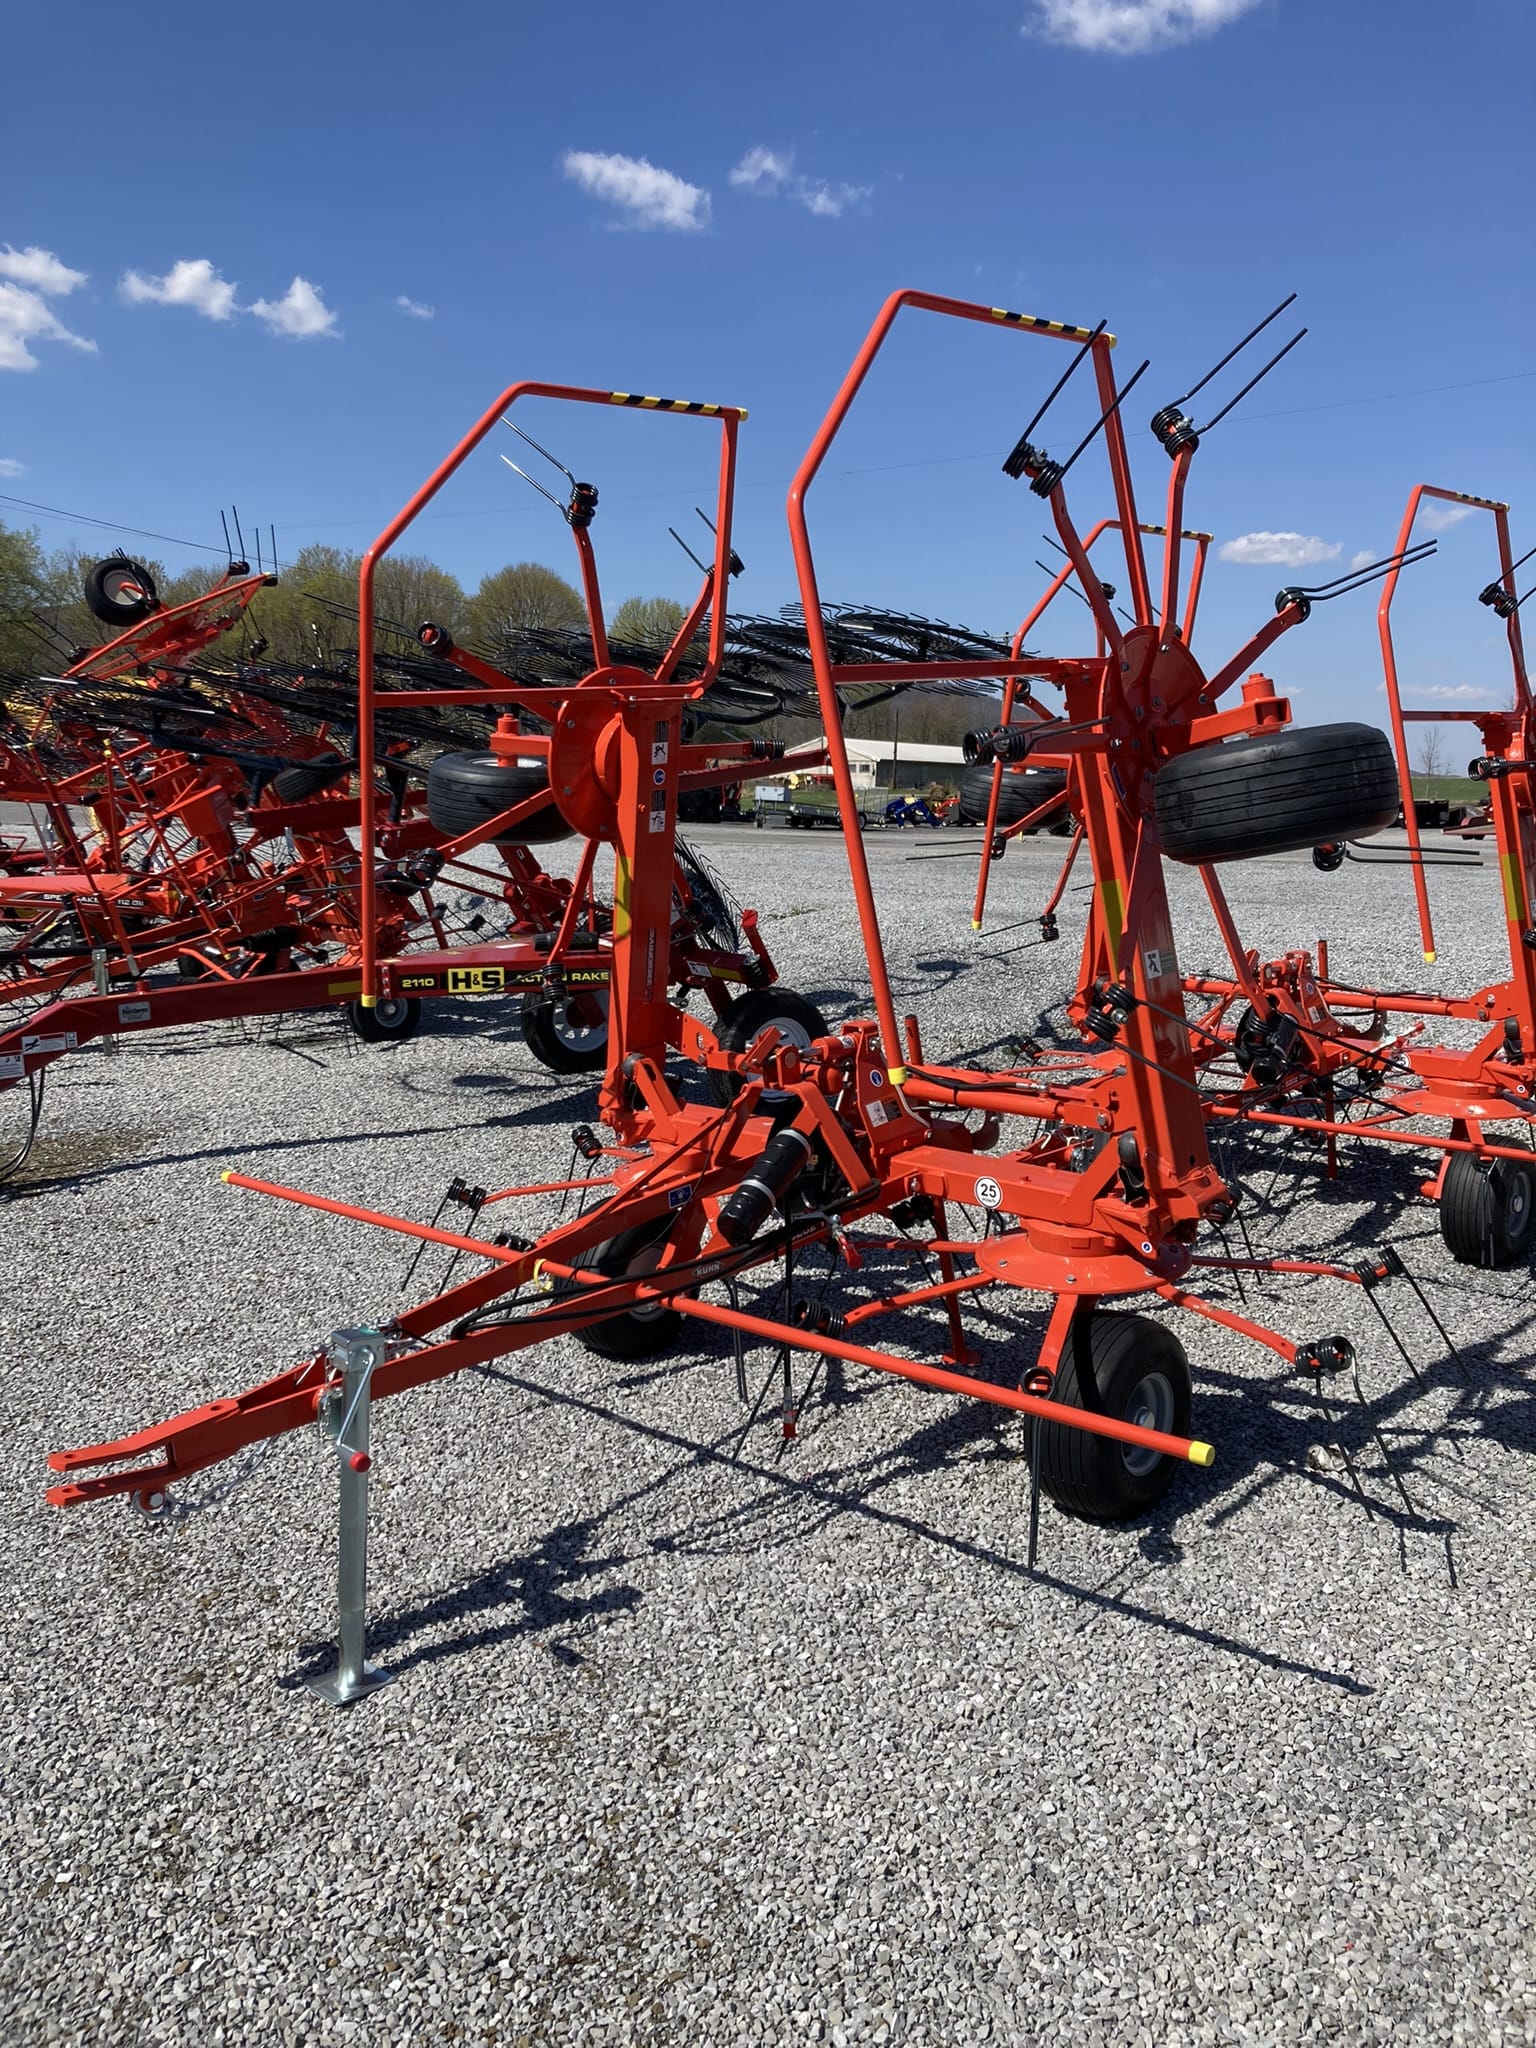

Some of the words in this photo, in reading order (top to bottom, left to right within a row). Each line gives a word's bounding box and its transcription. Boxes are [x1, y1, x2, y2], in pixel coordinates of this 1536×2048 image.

[402, 978, 435, 988] 2110
[452, 970, 501, 990] H&S
[571, 971, 609, 982] RAKE
[980, 1183, 997, 1198] 25
[695, 1262, 720, 1278] KUHN
